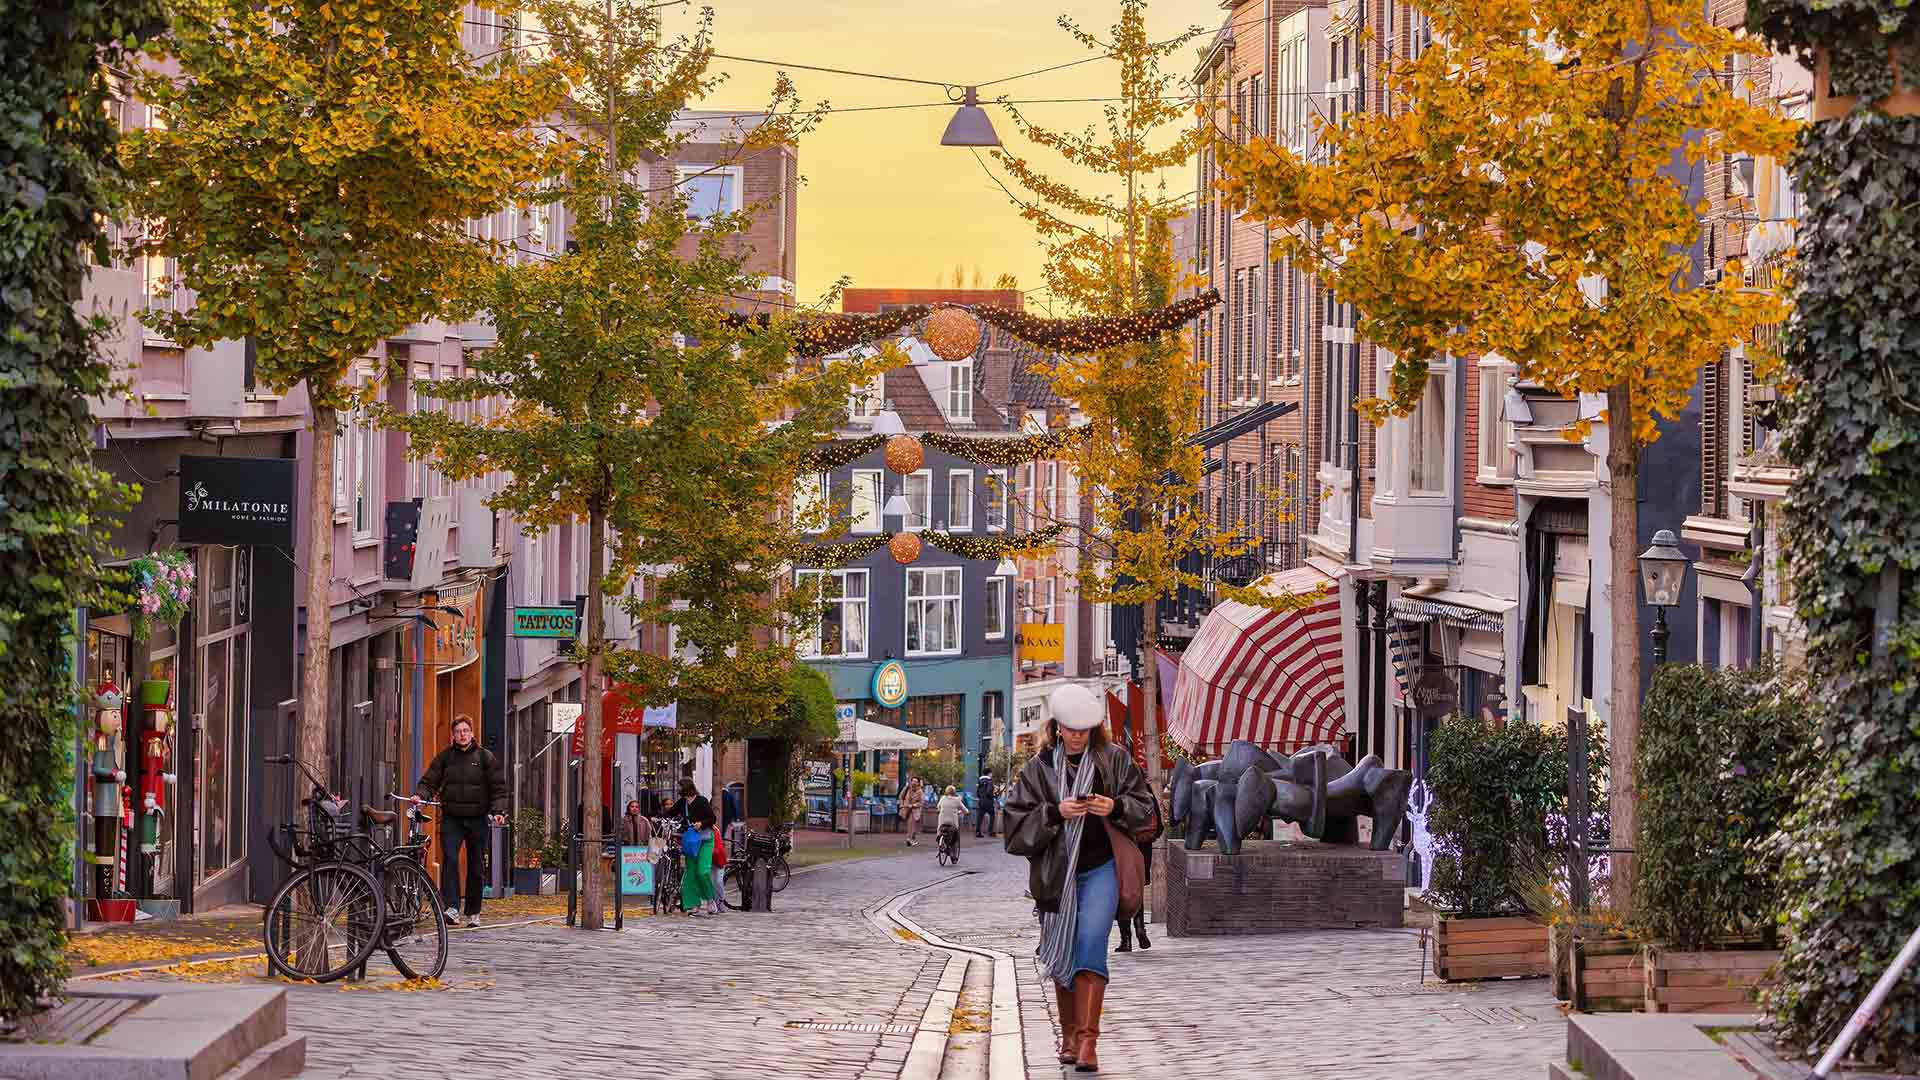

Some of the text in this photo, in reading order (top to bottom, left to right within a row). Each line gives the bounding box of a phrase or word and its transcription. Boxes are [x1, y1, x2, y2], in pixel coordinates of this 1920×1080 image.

[202, 500, 288, 514] MILATONIE
[517, 614, 574, 630] TATTOOS
[1026, 637, 1060, 648] KAAS
